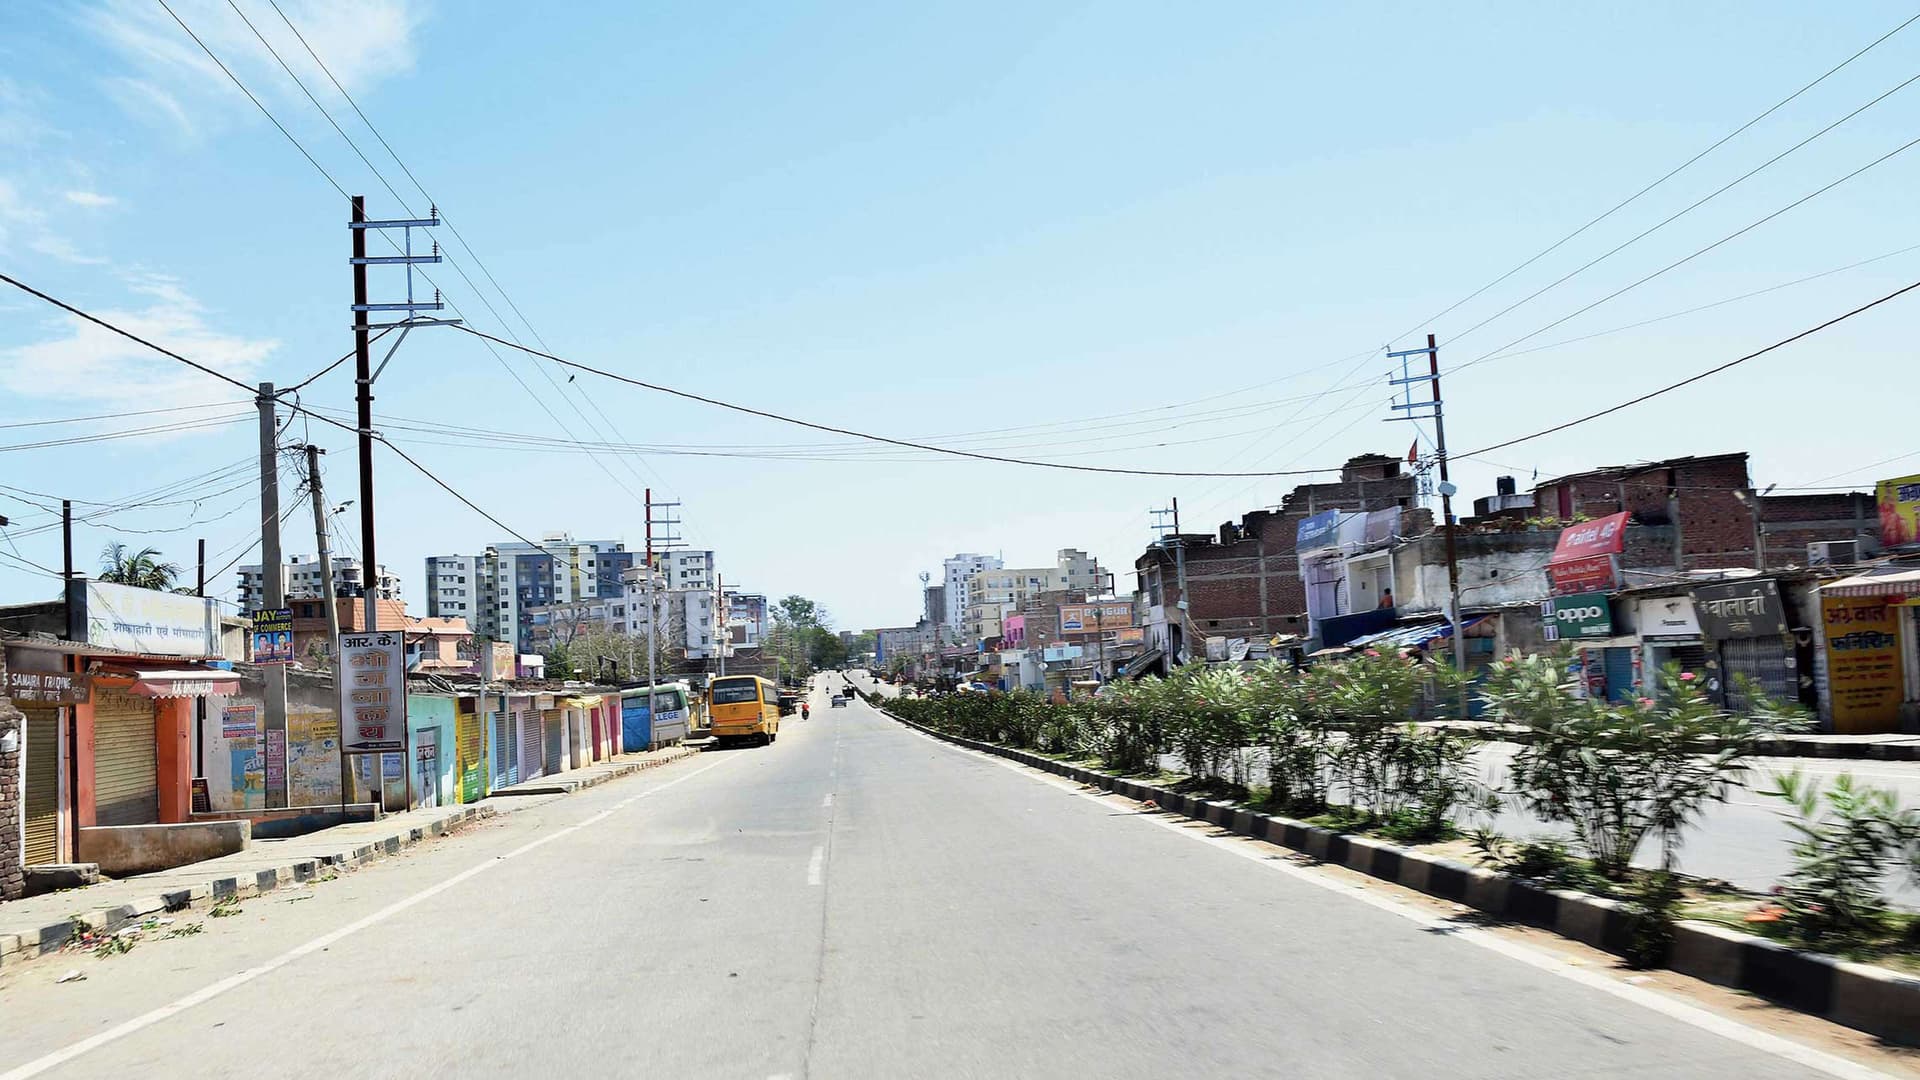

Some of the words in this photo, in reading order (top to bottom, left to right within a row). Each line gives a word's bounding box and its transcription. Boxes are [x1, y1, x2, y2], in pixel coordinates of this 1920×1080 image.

[254, 610, 276, 622] JAY
[1557, 606, 1604, 623] oppo
[260, 622, 291, 632] COMMERCE
[343, 637, 373, 648] आर.
[376, 633, 397, 646] के.
